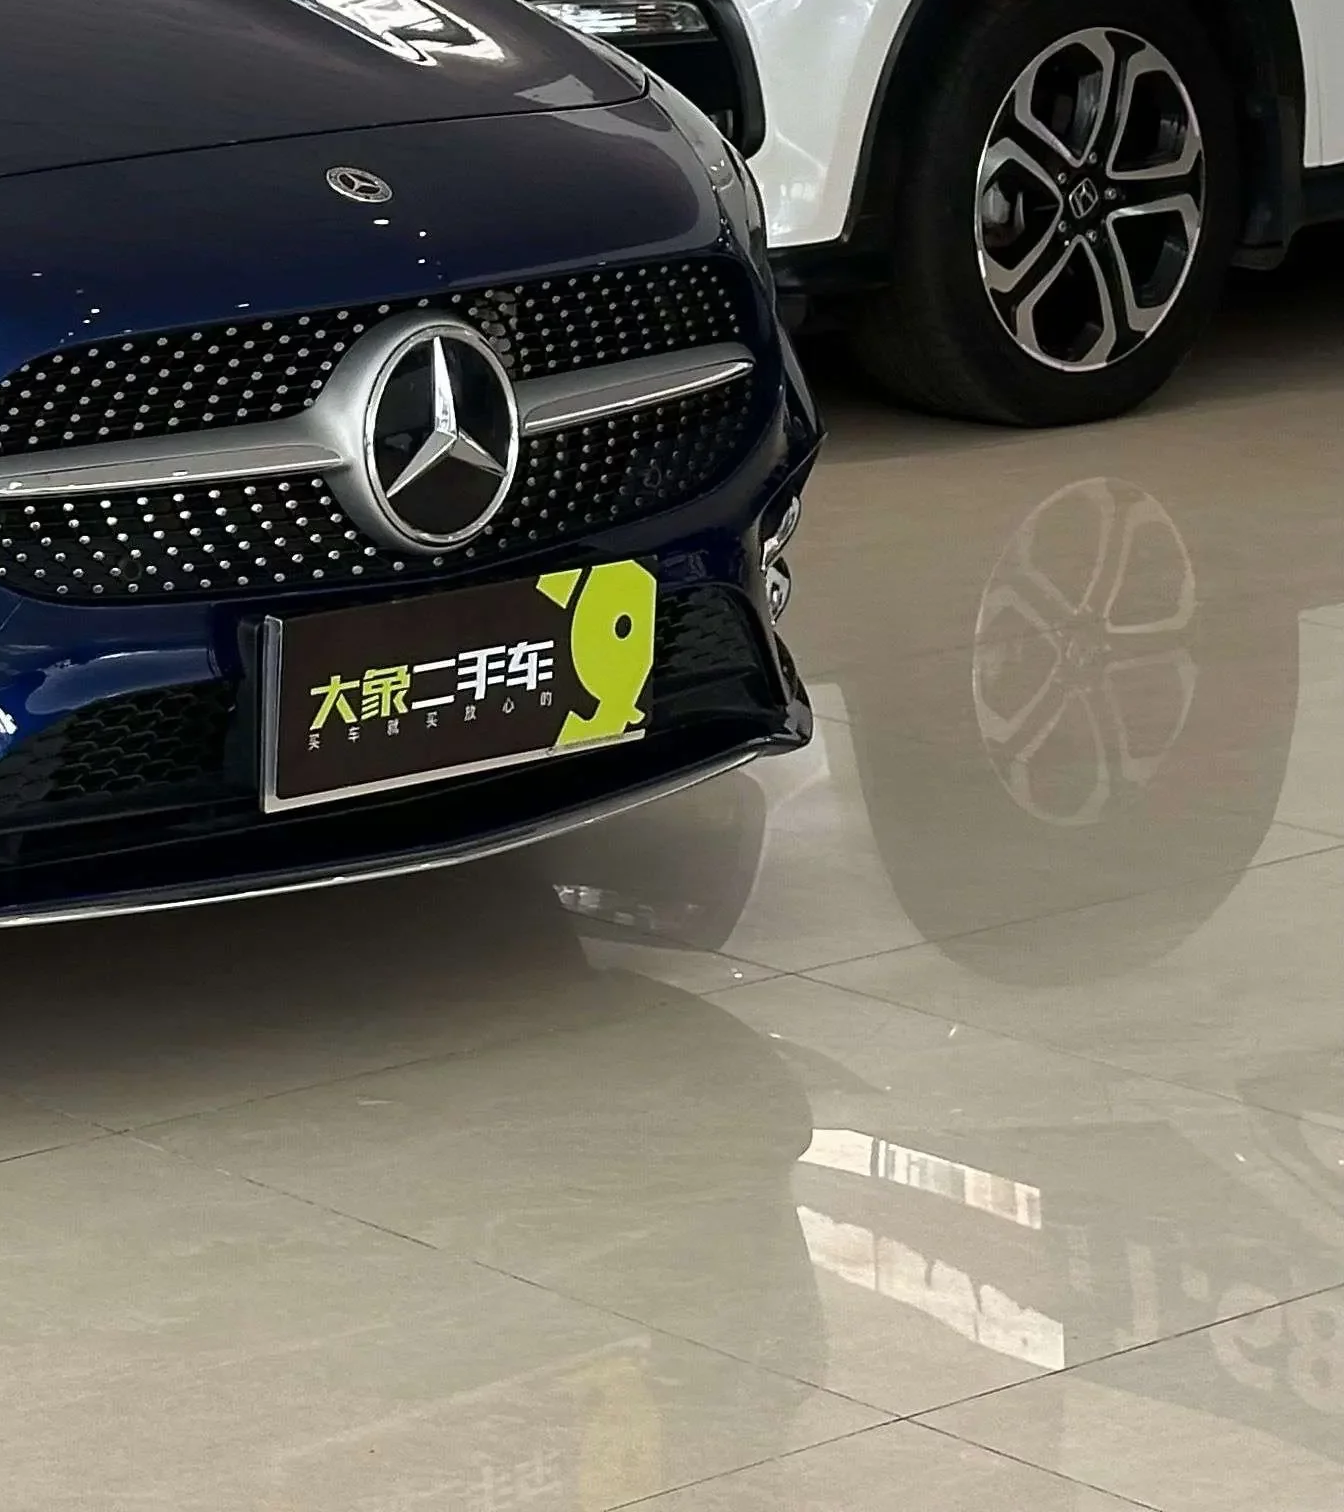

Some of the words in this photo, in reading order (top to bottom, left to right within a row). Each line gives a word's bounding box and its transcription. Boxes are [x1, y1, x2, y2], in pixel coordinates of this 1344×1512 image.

[309, 639, 555, 730] 大象二手车
